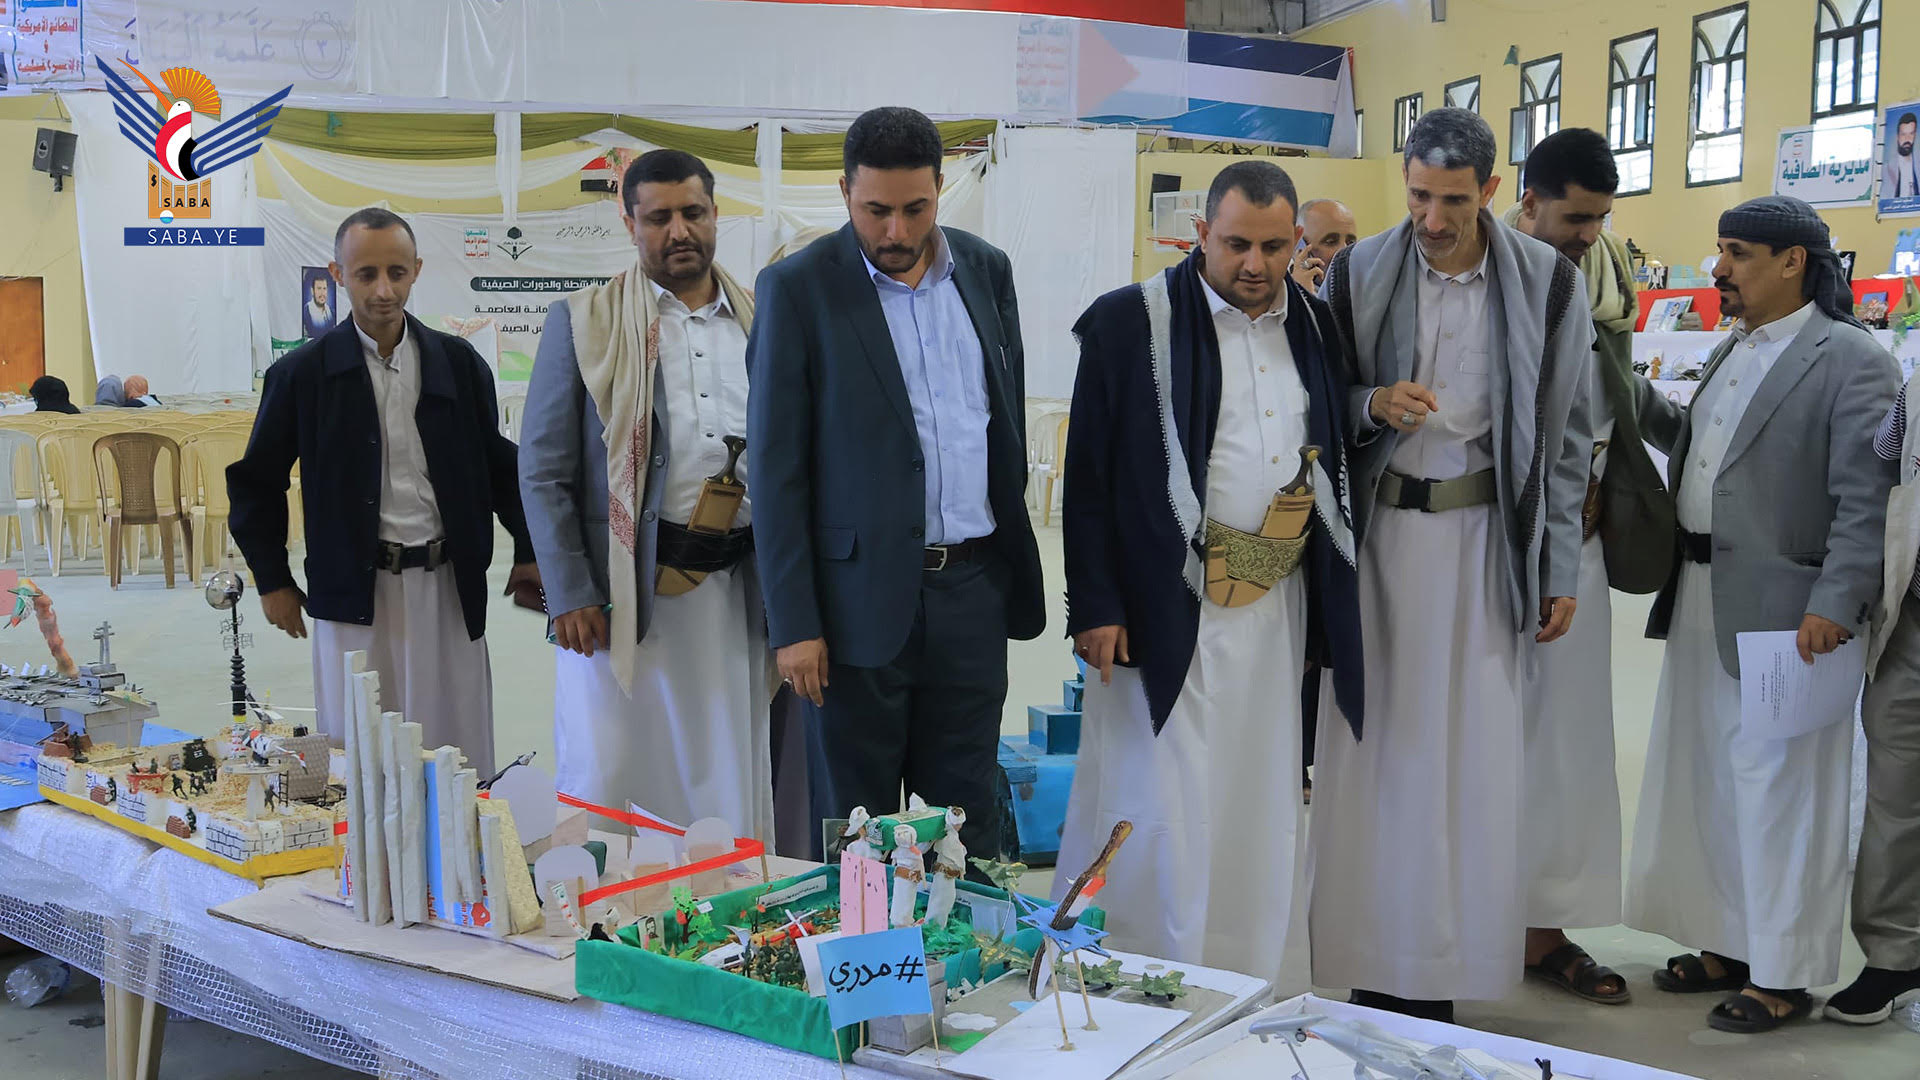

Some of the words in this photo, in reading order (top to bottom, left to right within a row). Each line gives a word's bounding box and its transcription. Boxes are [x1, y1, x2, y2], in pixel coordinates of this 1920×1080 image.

[1782, 159, 1826, 186] الصافية
[1828, 156, 1869, 184] مديرية
[481, 279, 519, 290] الصيفية
[521, 279, 561, 291] والدورات
[474, 304, 521, 313] العاصمة
[524, 304, 548, 313] مانة
